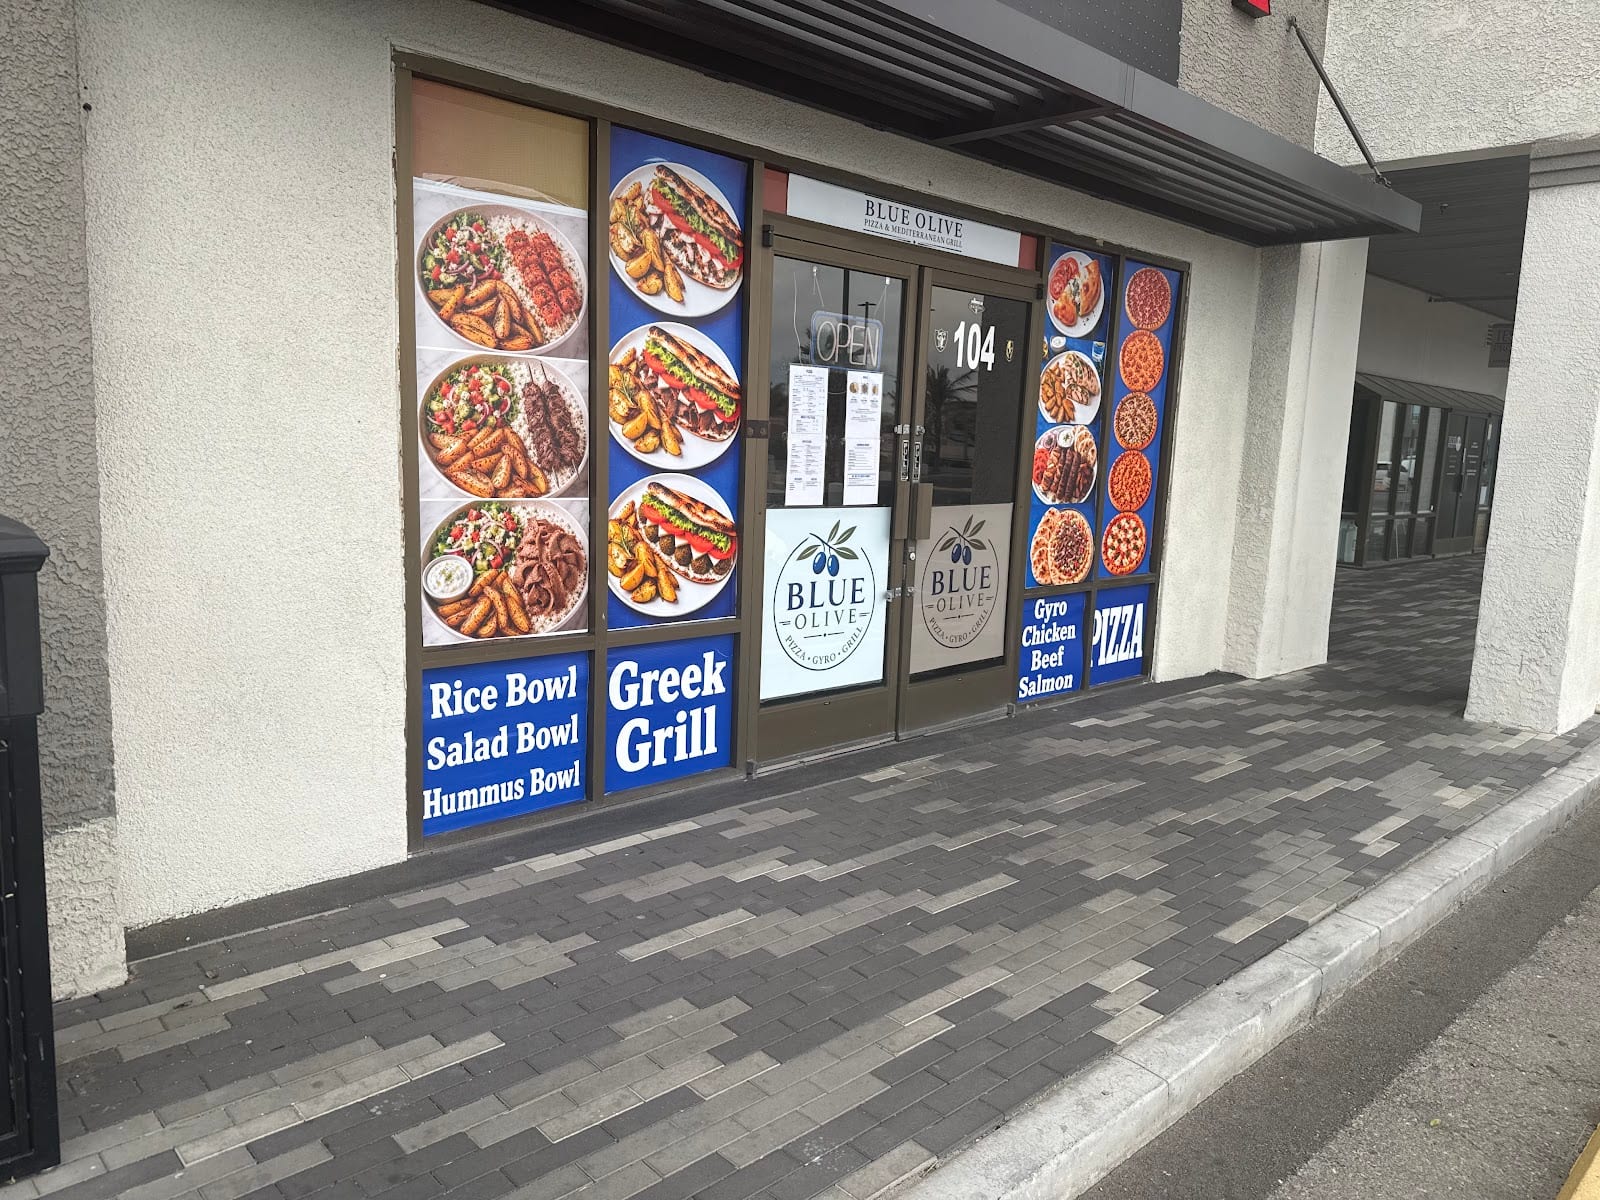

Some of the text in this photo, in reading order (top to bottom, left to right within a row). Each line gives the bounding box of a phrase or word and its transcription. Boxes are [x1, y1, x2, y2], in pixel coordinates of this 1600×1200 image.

[864, 199, 963, 238] BLUE OLIVE
[864, 218, 962, 248] PIZZA & MEDITERRANEAN GRILL
[816, 321, 879, 367] OPEN
[953, 320, 996, 371] 104
[787, 577, 865, 611] BLUE
[931, 566, 991, 596] BLUE
[794, 608, 857, 630] OLIVE
[936, 593, 985, 613] OLIVE
[1034, 598, 1068, 623] Gyro
[929, 609, 989, 643] PIZZA GYRO GRILL
[1021, 622, 1076, 648] Chicken
[1091, 602, 1144, 668] PIZZA
[785, 625, 863, 665] PIZZA GYRO GRILL
[1030, 645, 1065, 672] Beef
[429, 664, 577, 720] Rice Bowl
[608, 650, 727, 711] Greek
[1018, 673, 1073, 699] Salmon
[426, 713, 579, 772] Salad Bowl
[615, 705, 718, 773] Grill
[422, 760, 580, 820] Hummus Bowl
